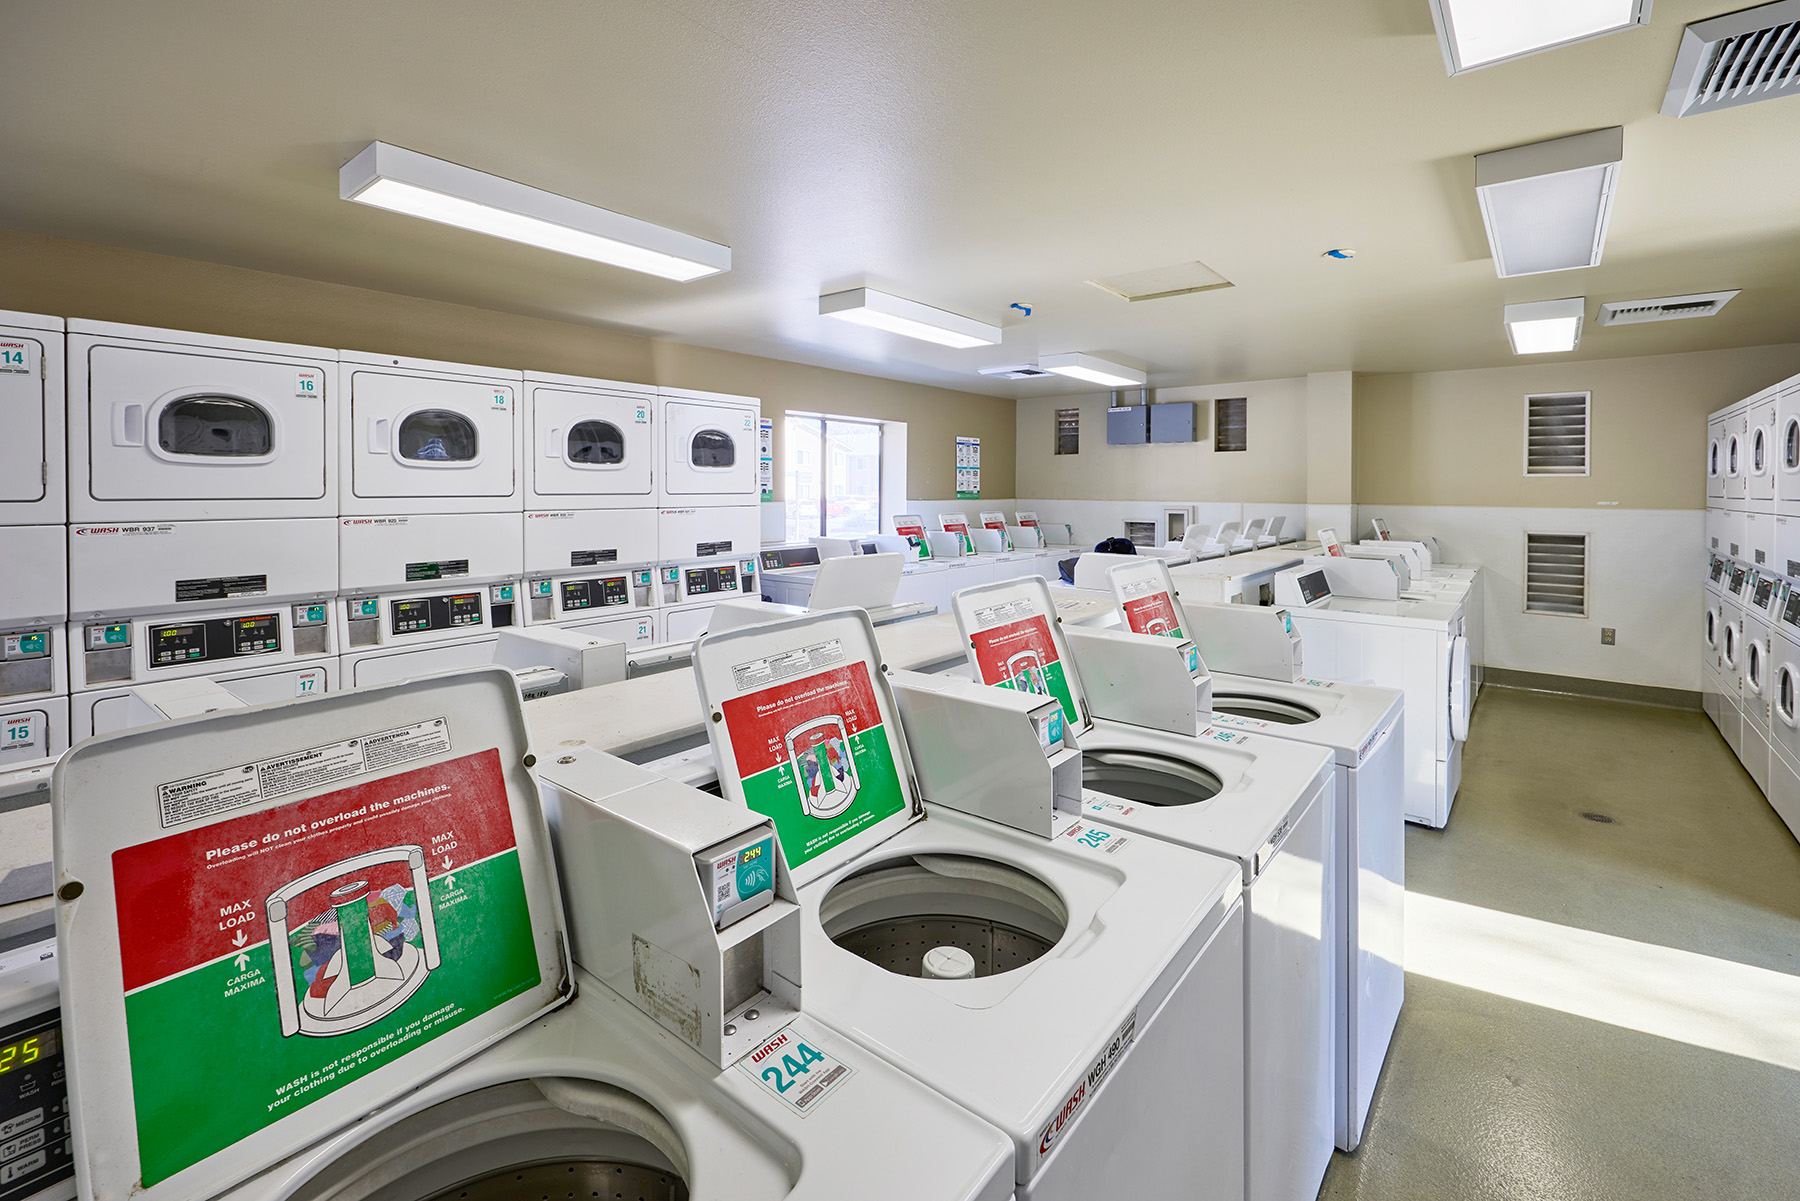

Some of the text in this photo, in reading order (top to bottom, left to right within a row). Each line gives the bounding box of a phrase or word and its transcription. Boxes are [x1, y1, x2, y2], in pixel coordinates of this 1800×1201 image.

[1, 350, 24, 364] 14
[299, 380, 314, 391] 16
[494, 395, 505, 405] 18
[636, 410, 645, 419] 20
[744, 419, 751, 427] 22
[638, 626, 647, 634] 21
[300, 680, 315, 691] 17
[757, 703, 776, 713] Please
[785, 696, 794, 704] not
[794, 689, 816, 700] overload
[846, 715, 858, 723] LOAD
[8, 725, 29, 740] 15
[368, 731, 410, 745] ADVERTENCIA
[767, 736, 780, 744] MAX
[769, 743, 783, 753] LOAD
[266, 752, 323, 770] AVERTISSEMENT
[169, 780, 207, 794] WARNING
[206, 783, 451, 860] Please do not overload the machines.
[431, 831, 454, 845] MAX
[1077, 829, 1111, 848] 245
[206, 855, 246, 870] Overloading
[260, 845, 274, 854] NOT
[275, 841, 292, 849] clean
[431, 841, 458, 856] LOAD
[744, 846, 762, 863] 244
[716, 856, 737, 870] WASH
[440, 888, 464, 901] CARGA
[220, 899, 252, 917] MAX
[438, 895, 468, 911] MAXIMA
[219, 911, 256, 931] LOAD
[226, 968, 261, 987] CARGA
[224, 976, 265, 998] MAXIMA
[276, 1003, 455, 1096] WASH is not responsible if you damage
[751, 1033, 788, 1063] WASH
[267, 1007, 466, 1112] your clothing due to overloading or misuse.
[761, 1042, 825, 1094] 244
[1055, 1081, 1086, 1132] WASH
[1087, 1055, 1107, 1087] WGH
[1107, 1037, 1120, 1059] 490
[19, 1088, 40, 1099] WASH
[15, 1113, 41, 1128] MEDIUM
[19, 1138, 42, 1151] PRESS
[20, 1132, 40, 1145] PERM
[17, 1158, 39, 1171] WARM
